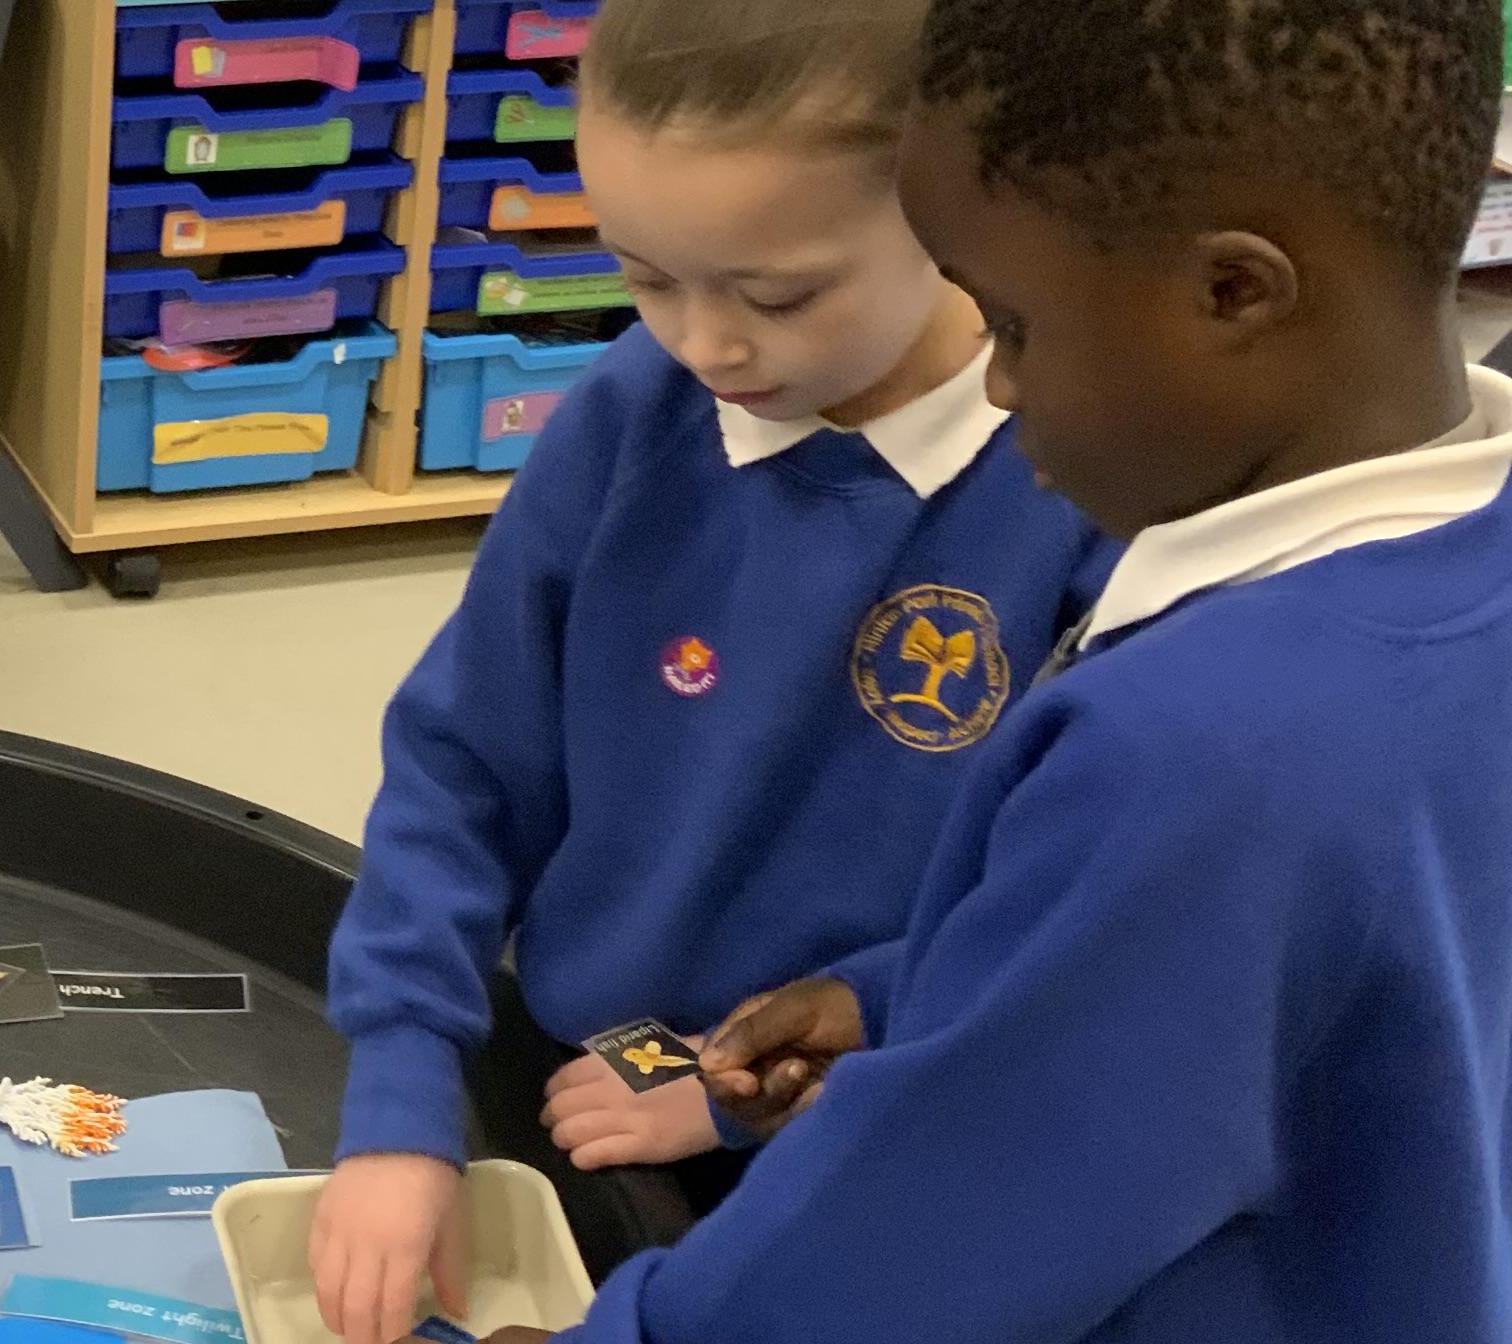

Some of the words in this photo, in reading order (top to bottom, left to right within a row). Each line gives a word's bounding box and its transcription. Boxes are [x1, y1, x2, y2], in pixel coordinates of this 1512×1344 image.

[59, 983, 126, 1000] Trench
[168, 1185, 215, 1197] zone
[107, 1297, 155, 1317] zone
